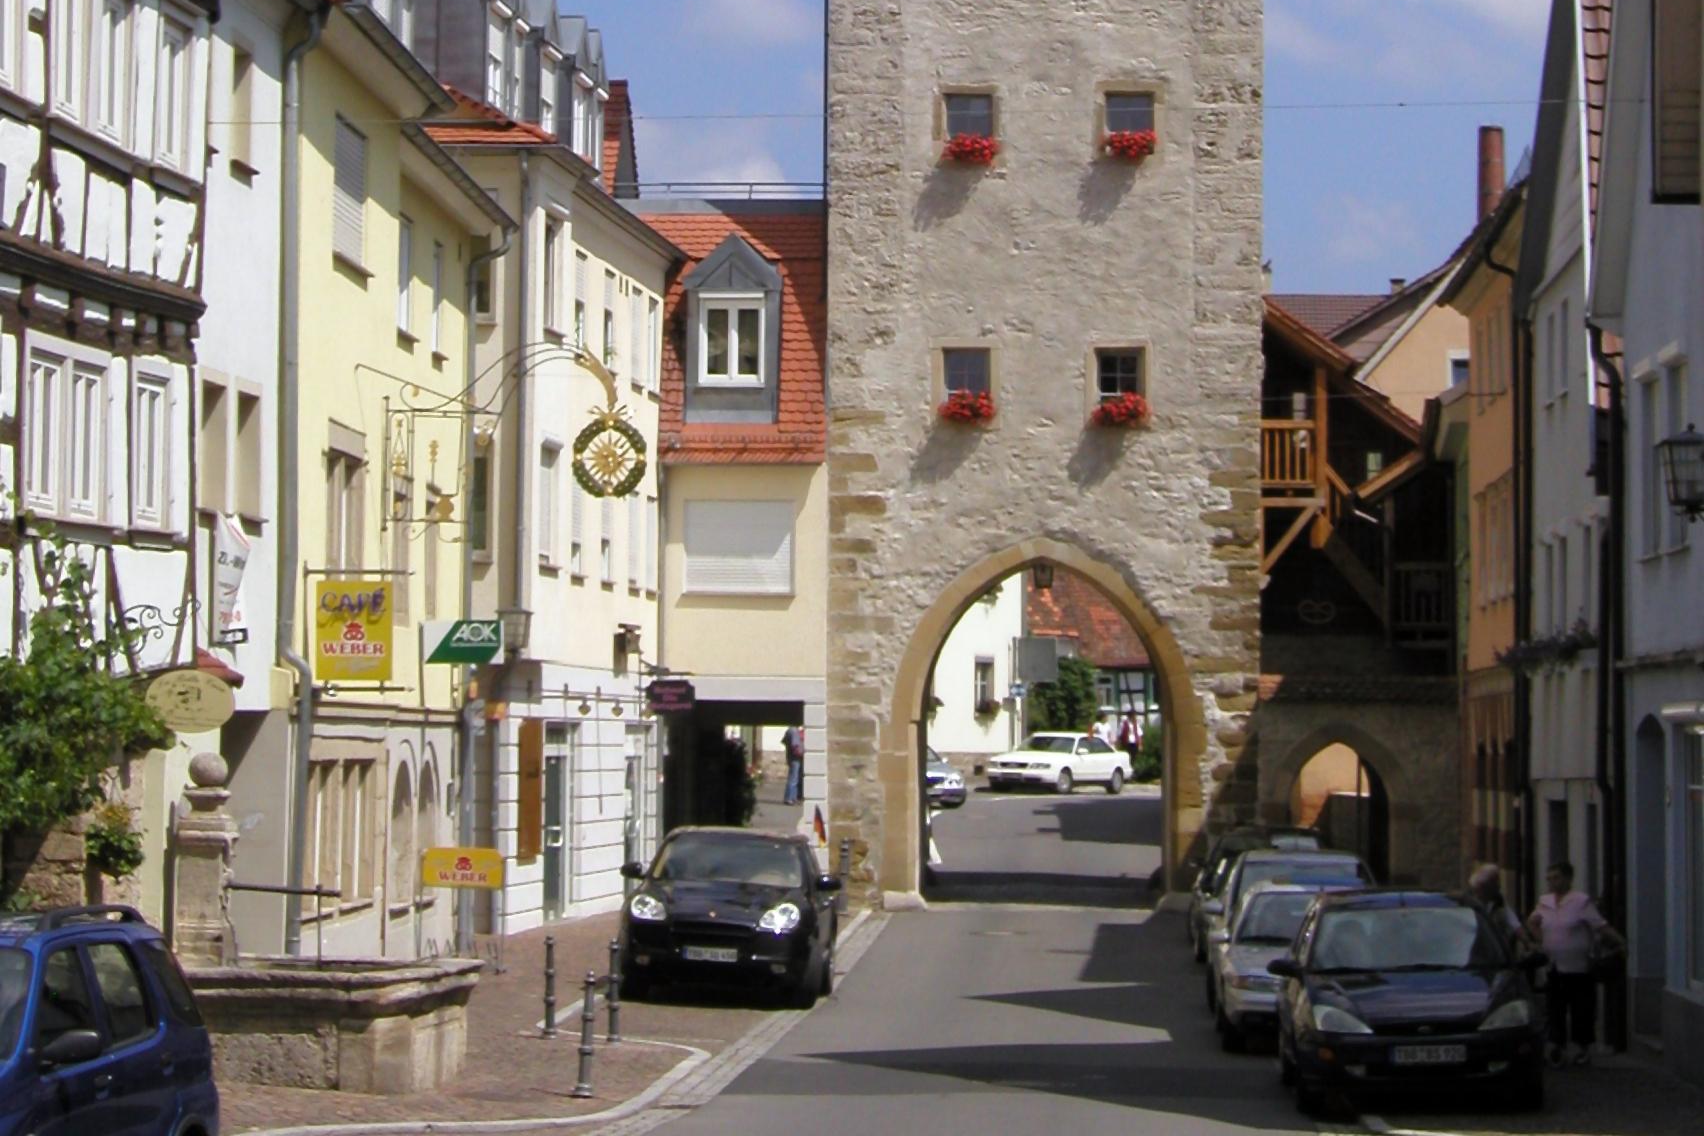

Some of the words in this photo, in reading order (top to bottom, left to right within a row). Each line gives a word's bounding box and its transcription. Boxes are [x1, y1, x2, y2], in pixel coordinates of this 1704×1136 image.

[452, 623, 498, 642] AOK
[322, 642, 385, 656] WEBER
[438, 871, 488, 883] WEBER
